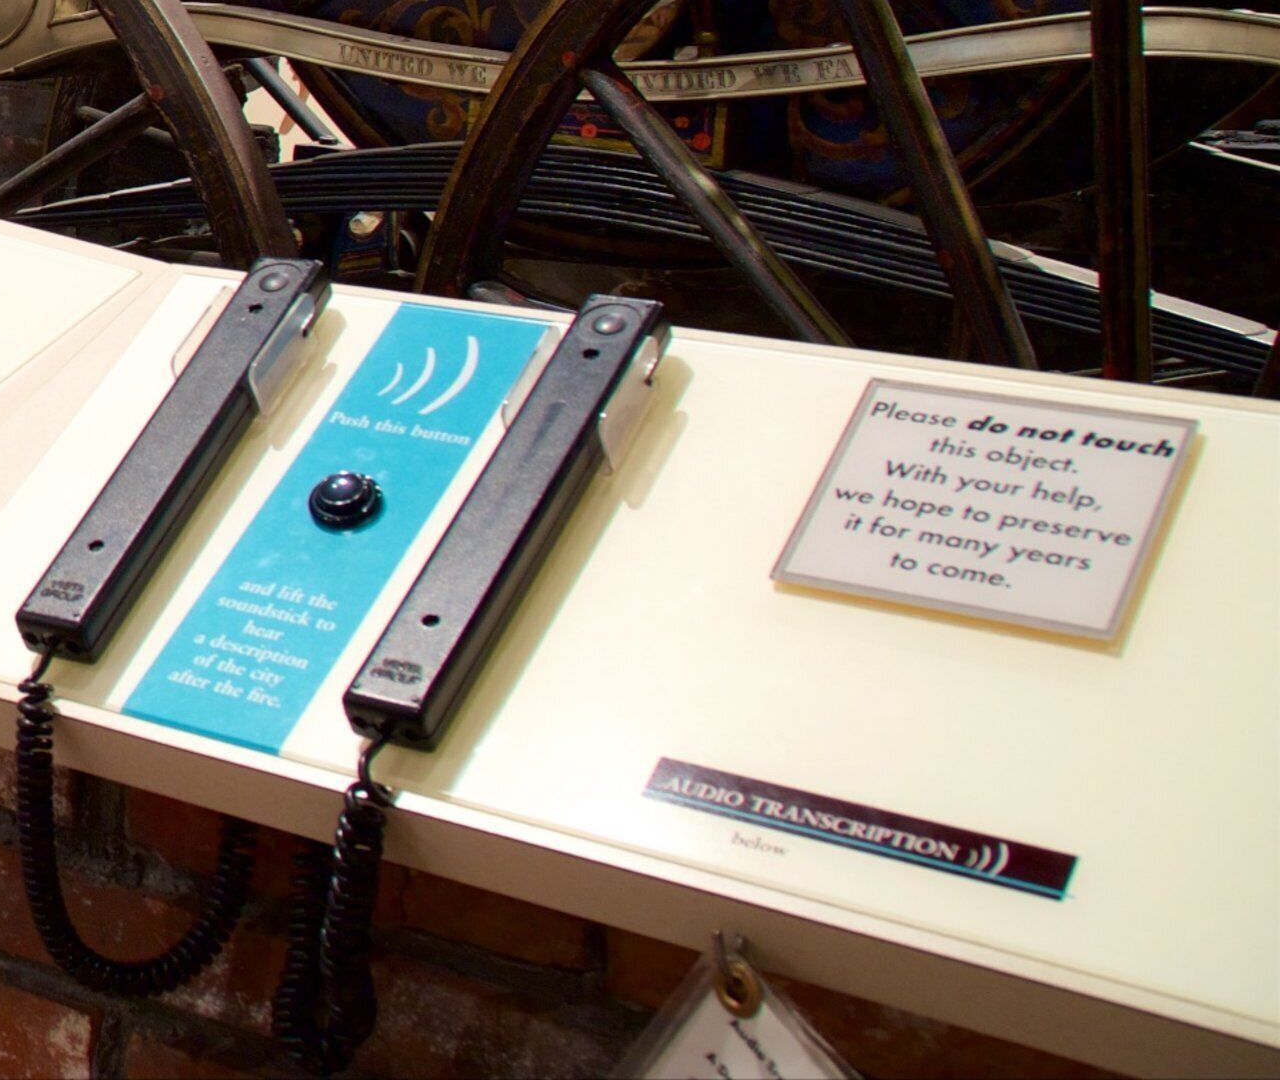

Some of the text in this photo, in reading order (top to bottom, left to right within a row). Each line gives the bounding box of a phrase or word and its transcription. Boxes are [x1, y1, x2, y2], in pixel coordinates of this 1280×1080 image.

[340, 43, 862, 92] UNITED WE IVIDED WE FA
[329, 411, 472, 446] Push this button
[870, 401, 1177, 459] Please do not touch
[929, 436, 1080, 475] this object.
[885, 459, 1104, 513] With your help,
[834, 486, 1133, 548] we hope to preserve
[843, 513, 1093, 572] it for many years
[889, 552, 1013, 590] to come.
[216, 596, 337, 632] soundstick to
[238, 579, 338, 611] and lift the
[243, 619, 284, 642] hear
[193, 634, 309, 670] a description
[193, 653, 285, 687] of the city
[167, 669, 282, 709] after the fire.
[663, 777, 962, 863] AUDIO TRANSCRIPTION
[731, 832, 789, 857] below
